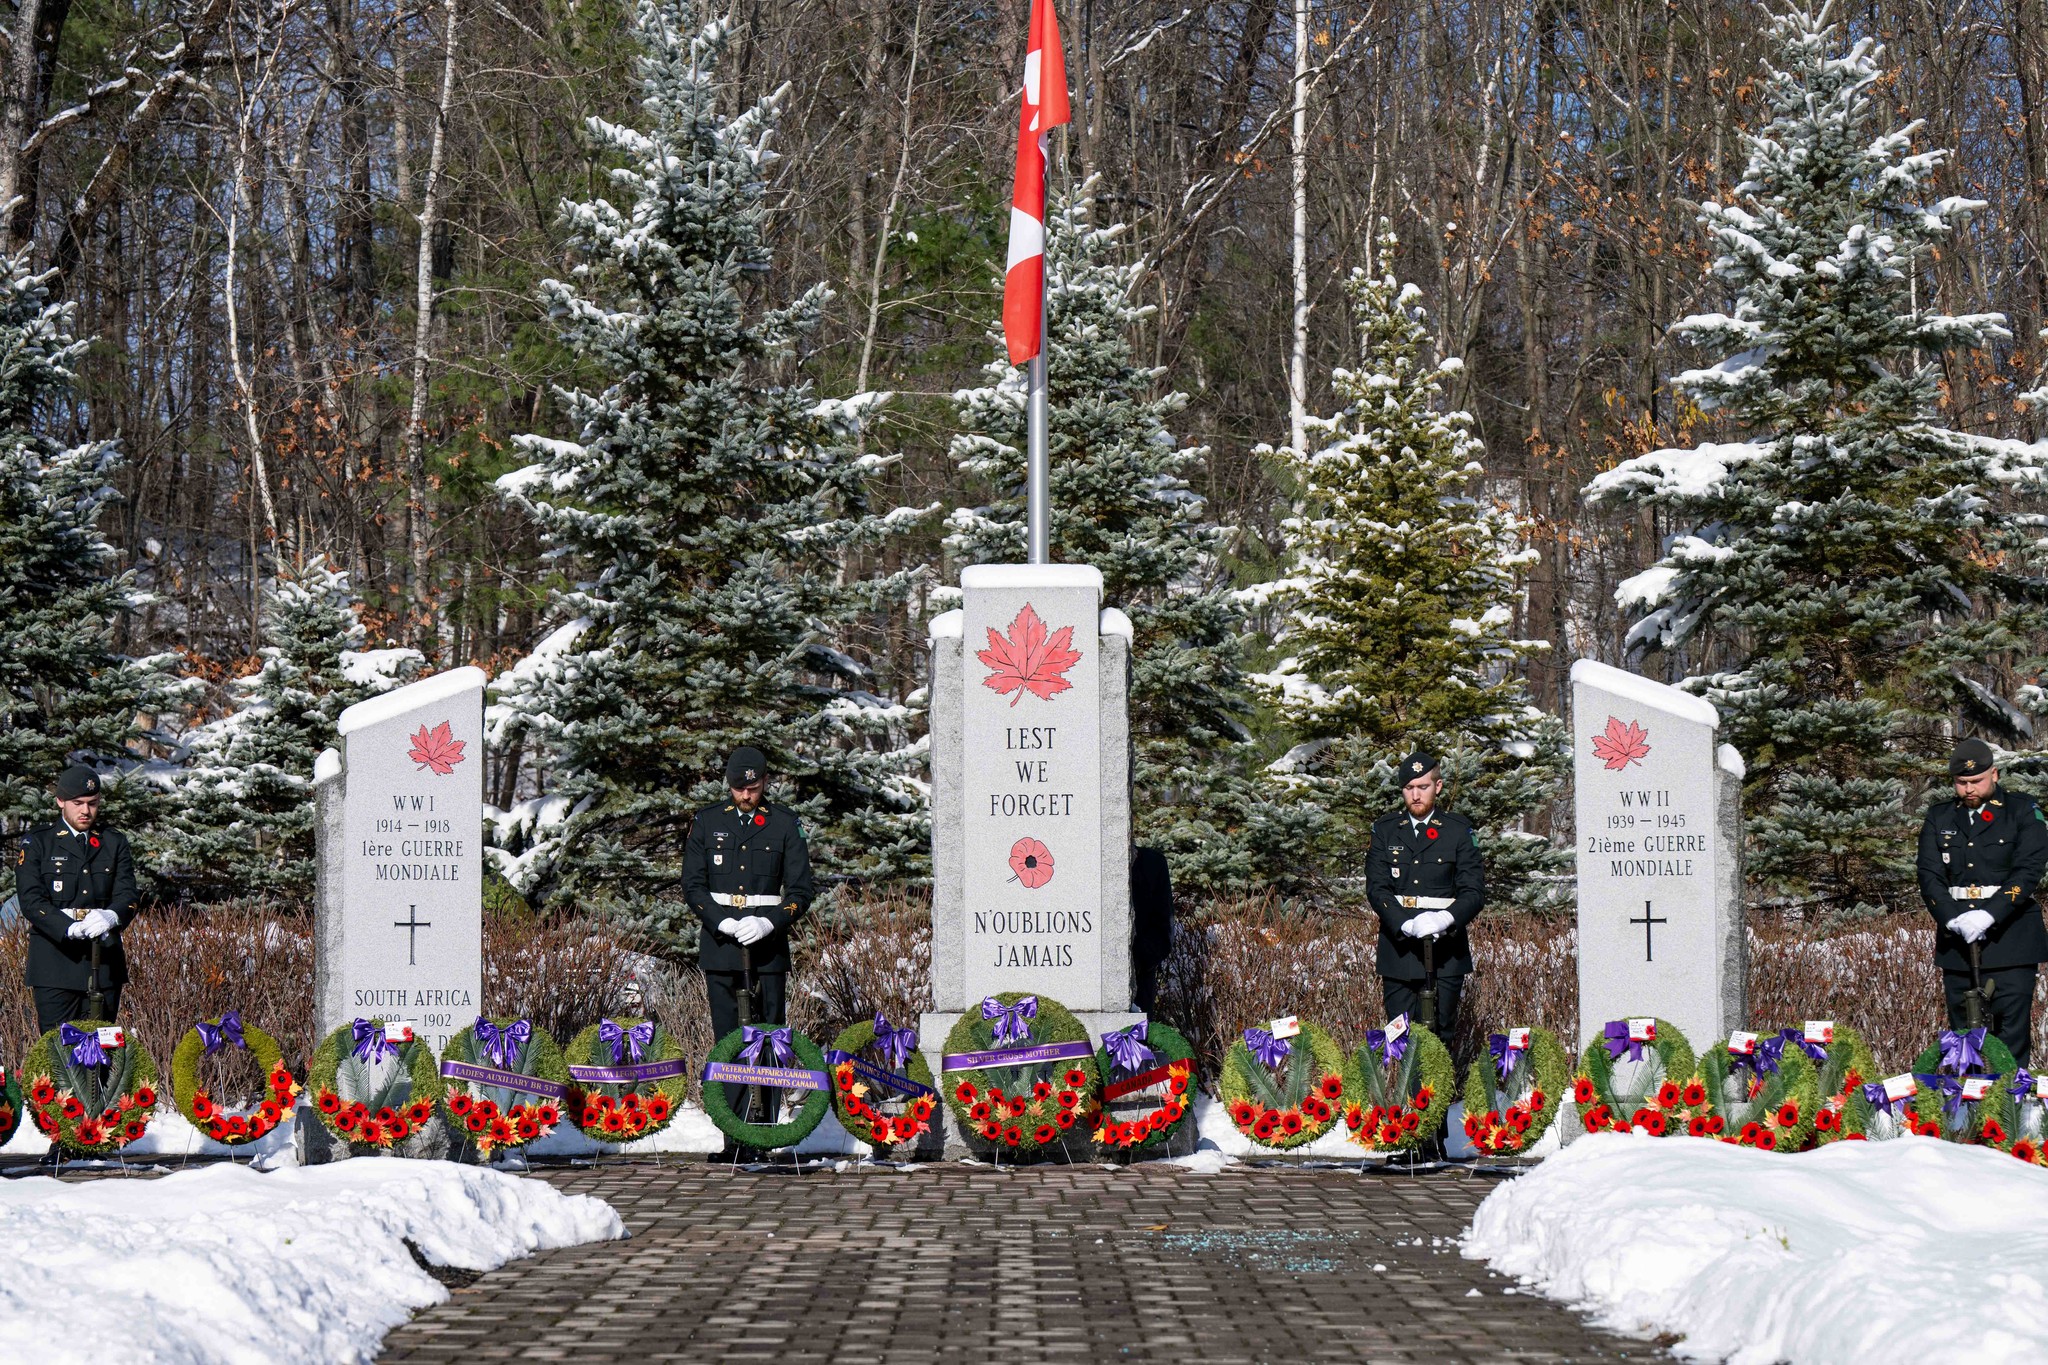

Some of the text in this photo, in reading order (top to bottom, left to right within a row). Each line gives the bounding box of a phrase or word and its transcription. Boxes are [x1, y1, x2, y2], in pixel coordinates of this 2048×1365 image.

[1006, 726, 1057, 750] LEST
[1015, 760, 1048, 783] WE
[990, 793, 1074, 817] FORGET
[376, 818, 403, 833] 1914
[425, 819, 450, 833] 1918
[1607, 814, 1635, 829] 1939
[1657, 814, 1686, 828] 1945
[401, 840, 464, 857] GUERRE
[1588, 835, 1706, 853] 2ième GUERRE
[376, 863, 459, 881] MONDIALE
[1610, 859, 1693, 877] MONDIALE
[974, 909, 1092, 935] N'OUBLIONS
[354, 989, 472, 1007] SOUTH AFRICA
[423, 1013, 452, 1027] 1902
[966, 1048, 1061, 1064] SILVER CROSS MOTHER
[455, 1067, 559, 1093] LADIES AUXILIARY BR 517
[615, 1068, 644, 1078] LEGION
[646, 1067, 658, 1076] BR
[713, 1072, 819, 1089] ANCIENS COMBATTANTS CANADA
[721, 1064, 812, 1080] VETERANS AFFAIRS CANADA
[881, 1073, 890, 1082] OF
[891, 1077, 920, 1093] ONTARIO
[1120, 1074, 1153, 1092] CANADA
